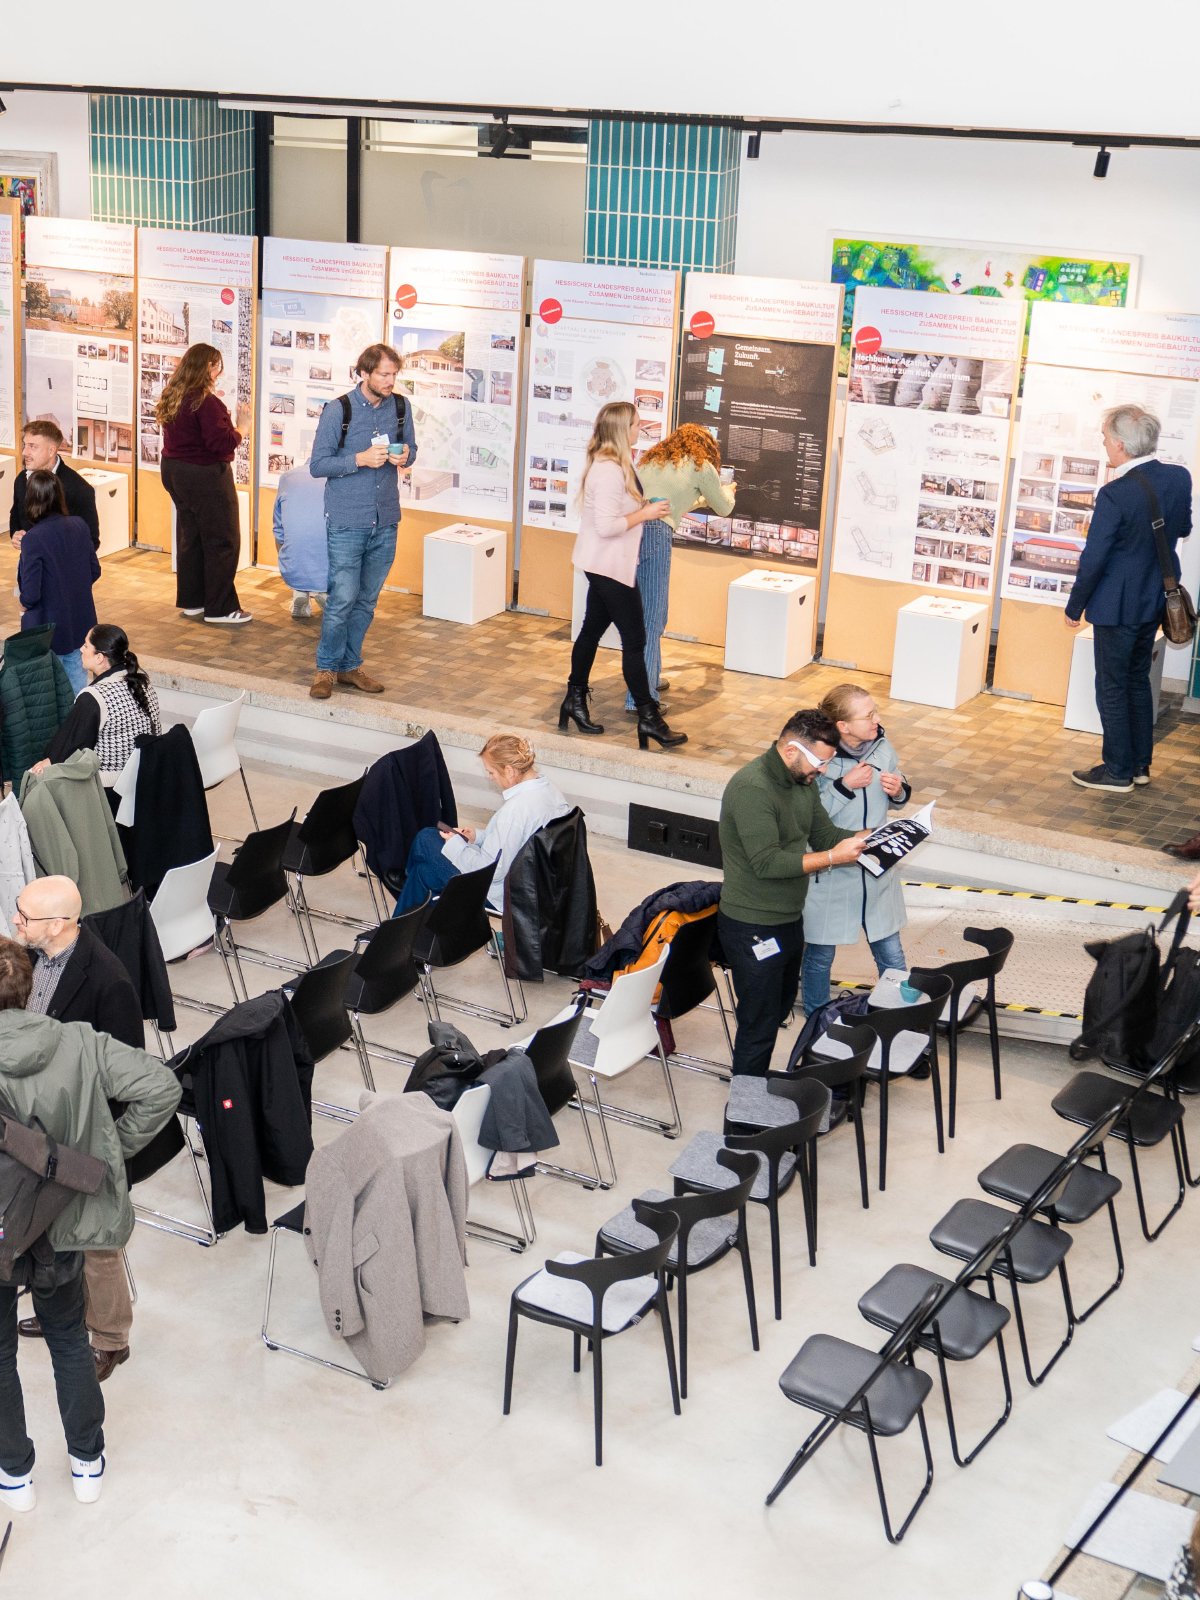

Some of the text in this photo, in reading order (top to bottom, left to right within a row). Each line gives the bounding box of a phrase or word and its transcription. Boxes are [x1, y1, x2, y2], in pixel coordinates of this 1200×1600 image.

[556, 280, 672, 295] HESSISCHER LANDESPREIS BAUKULTUR
[624, 294, 657, 302] UmGEBAUT
[710, 294, 749, 302] HESSISCHER
[750, 298, 795, 306] LANDESPREIS
[745, 305, 781, 313] ZUSAMMEN
[783, 308, 820, 316] UmGEBAUT
[881, 308, 1016, 326] HESSISCHER LANDESPREIS BAUKULTUR
[919, 321, 958, 330] ZUSAMMEN
[960, 325, 999, 334] UmGEBAUT
[1161, 334, 1200, 343] BAUKULTU
[735, 344, 772, 354] Gemeinsam.
[1144, 341, 1186, 350] UmGEBAUT
[734, 352, 760, 360] Zukunft.
[855, 353, 900, 364] Hochbunker
[900, 358, 930, 367] Agathof
[734, 360, 754, 368] Bauen.
[871, 364, 898, 374] Bunker
[916, 369, 970, 382] Kulturzentrum
